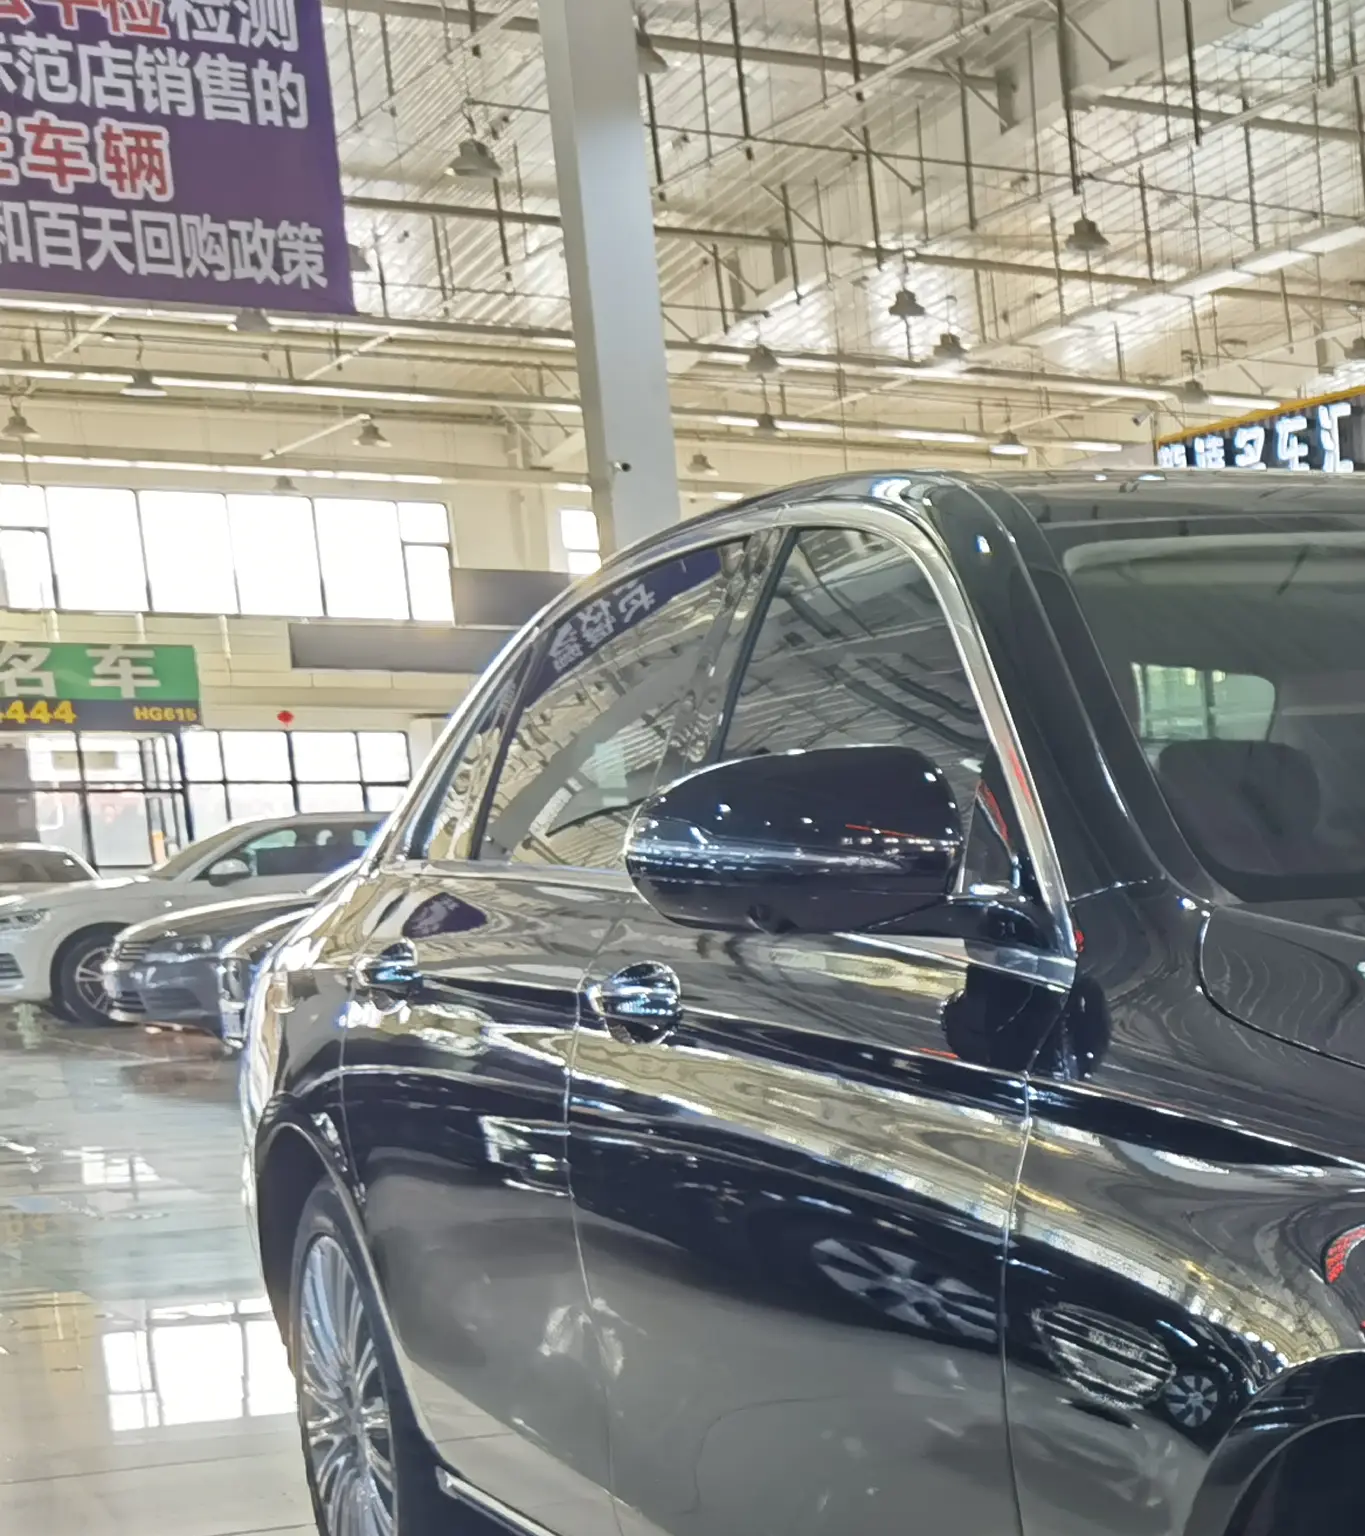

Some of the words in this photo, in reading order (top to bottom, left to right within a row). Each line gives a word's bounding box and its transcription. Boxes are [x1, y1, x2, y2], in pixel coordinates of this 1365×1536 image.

[0, 31, 308, 128] 范店销售的
[0, 110, 174, 201] 车辆
[0, 700, 76, 724] 444
